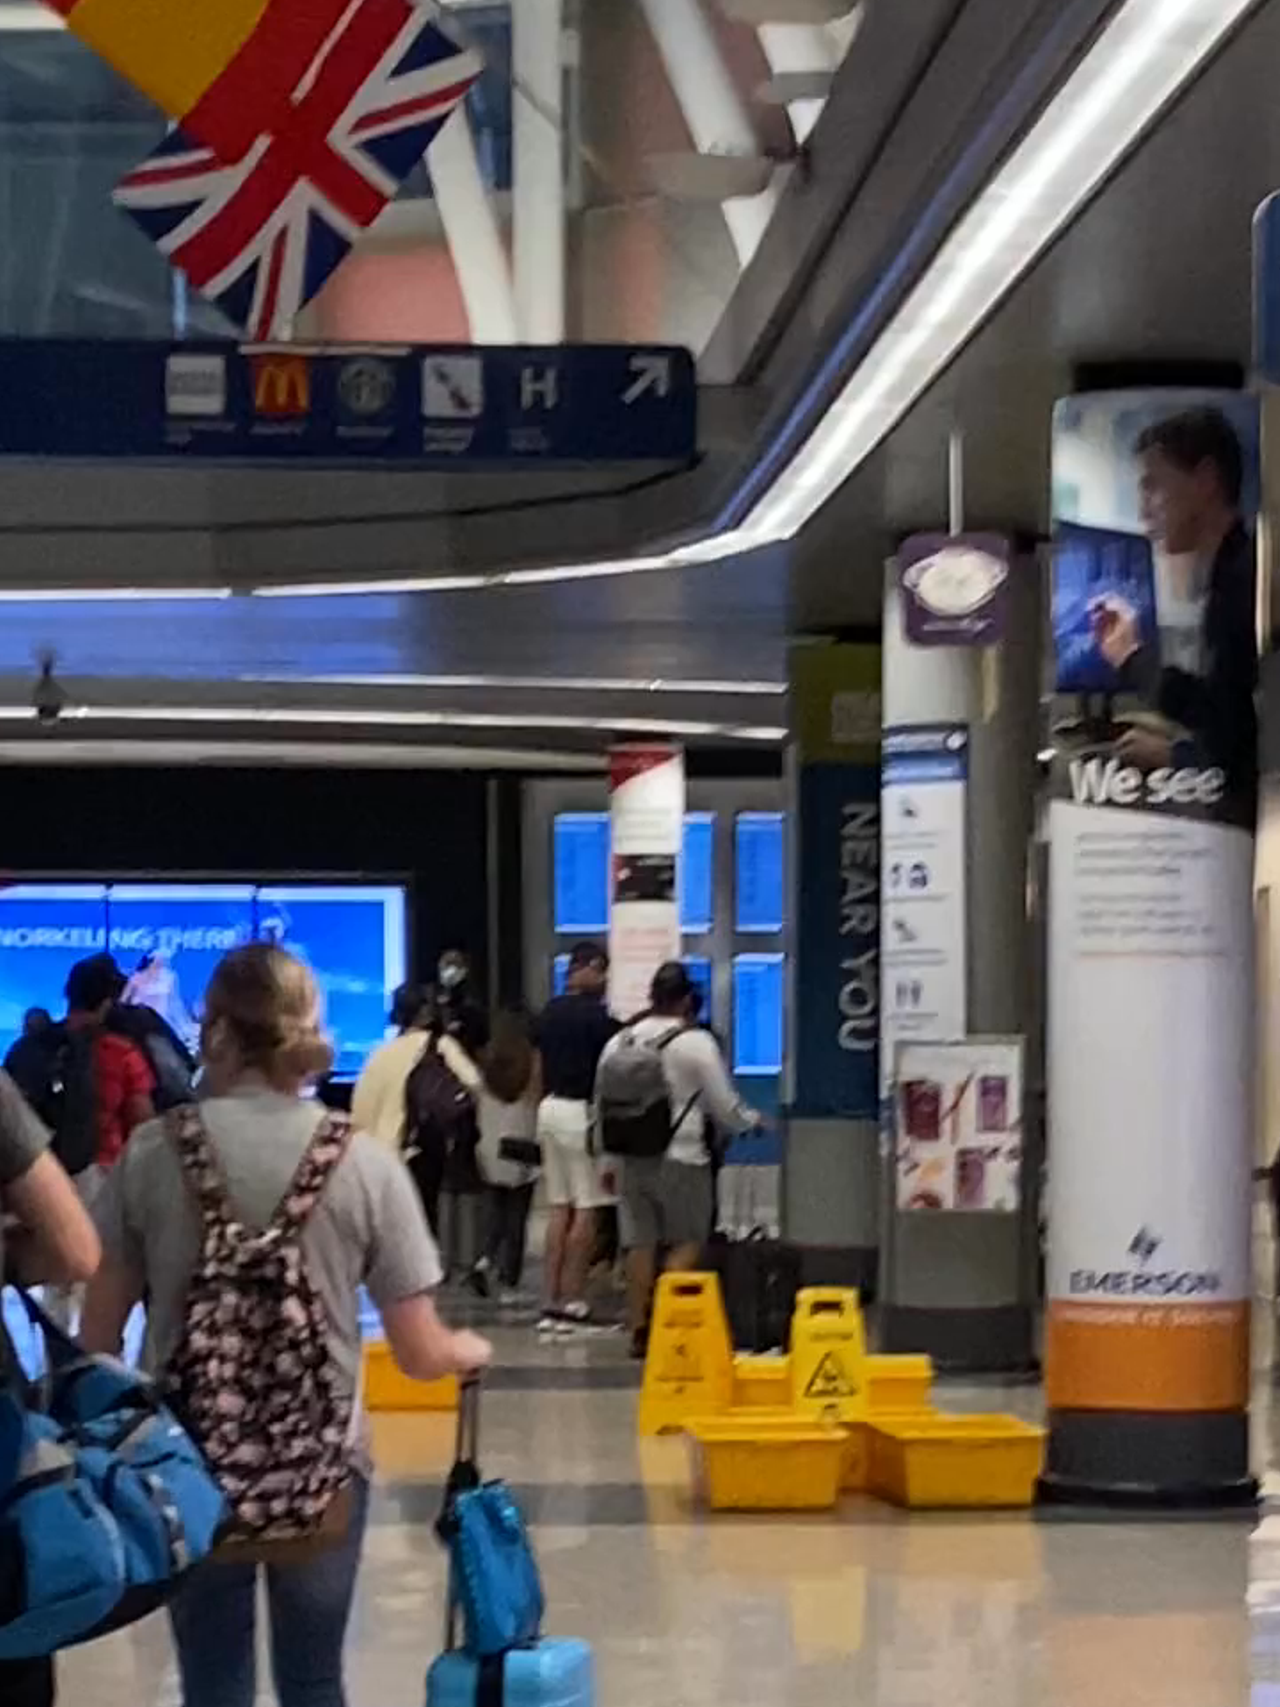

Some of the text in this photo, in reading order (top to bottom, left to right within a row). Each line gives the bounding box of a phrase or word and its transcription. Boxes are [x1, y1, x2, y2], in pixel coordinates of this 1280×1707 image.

[521, 366, 558, 409] H
[1069, 755, 1226, 805] We see
[837, 801, 879, 1052] NEAR YOU
